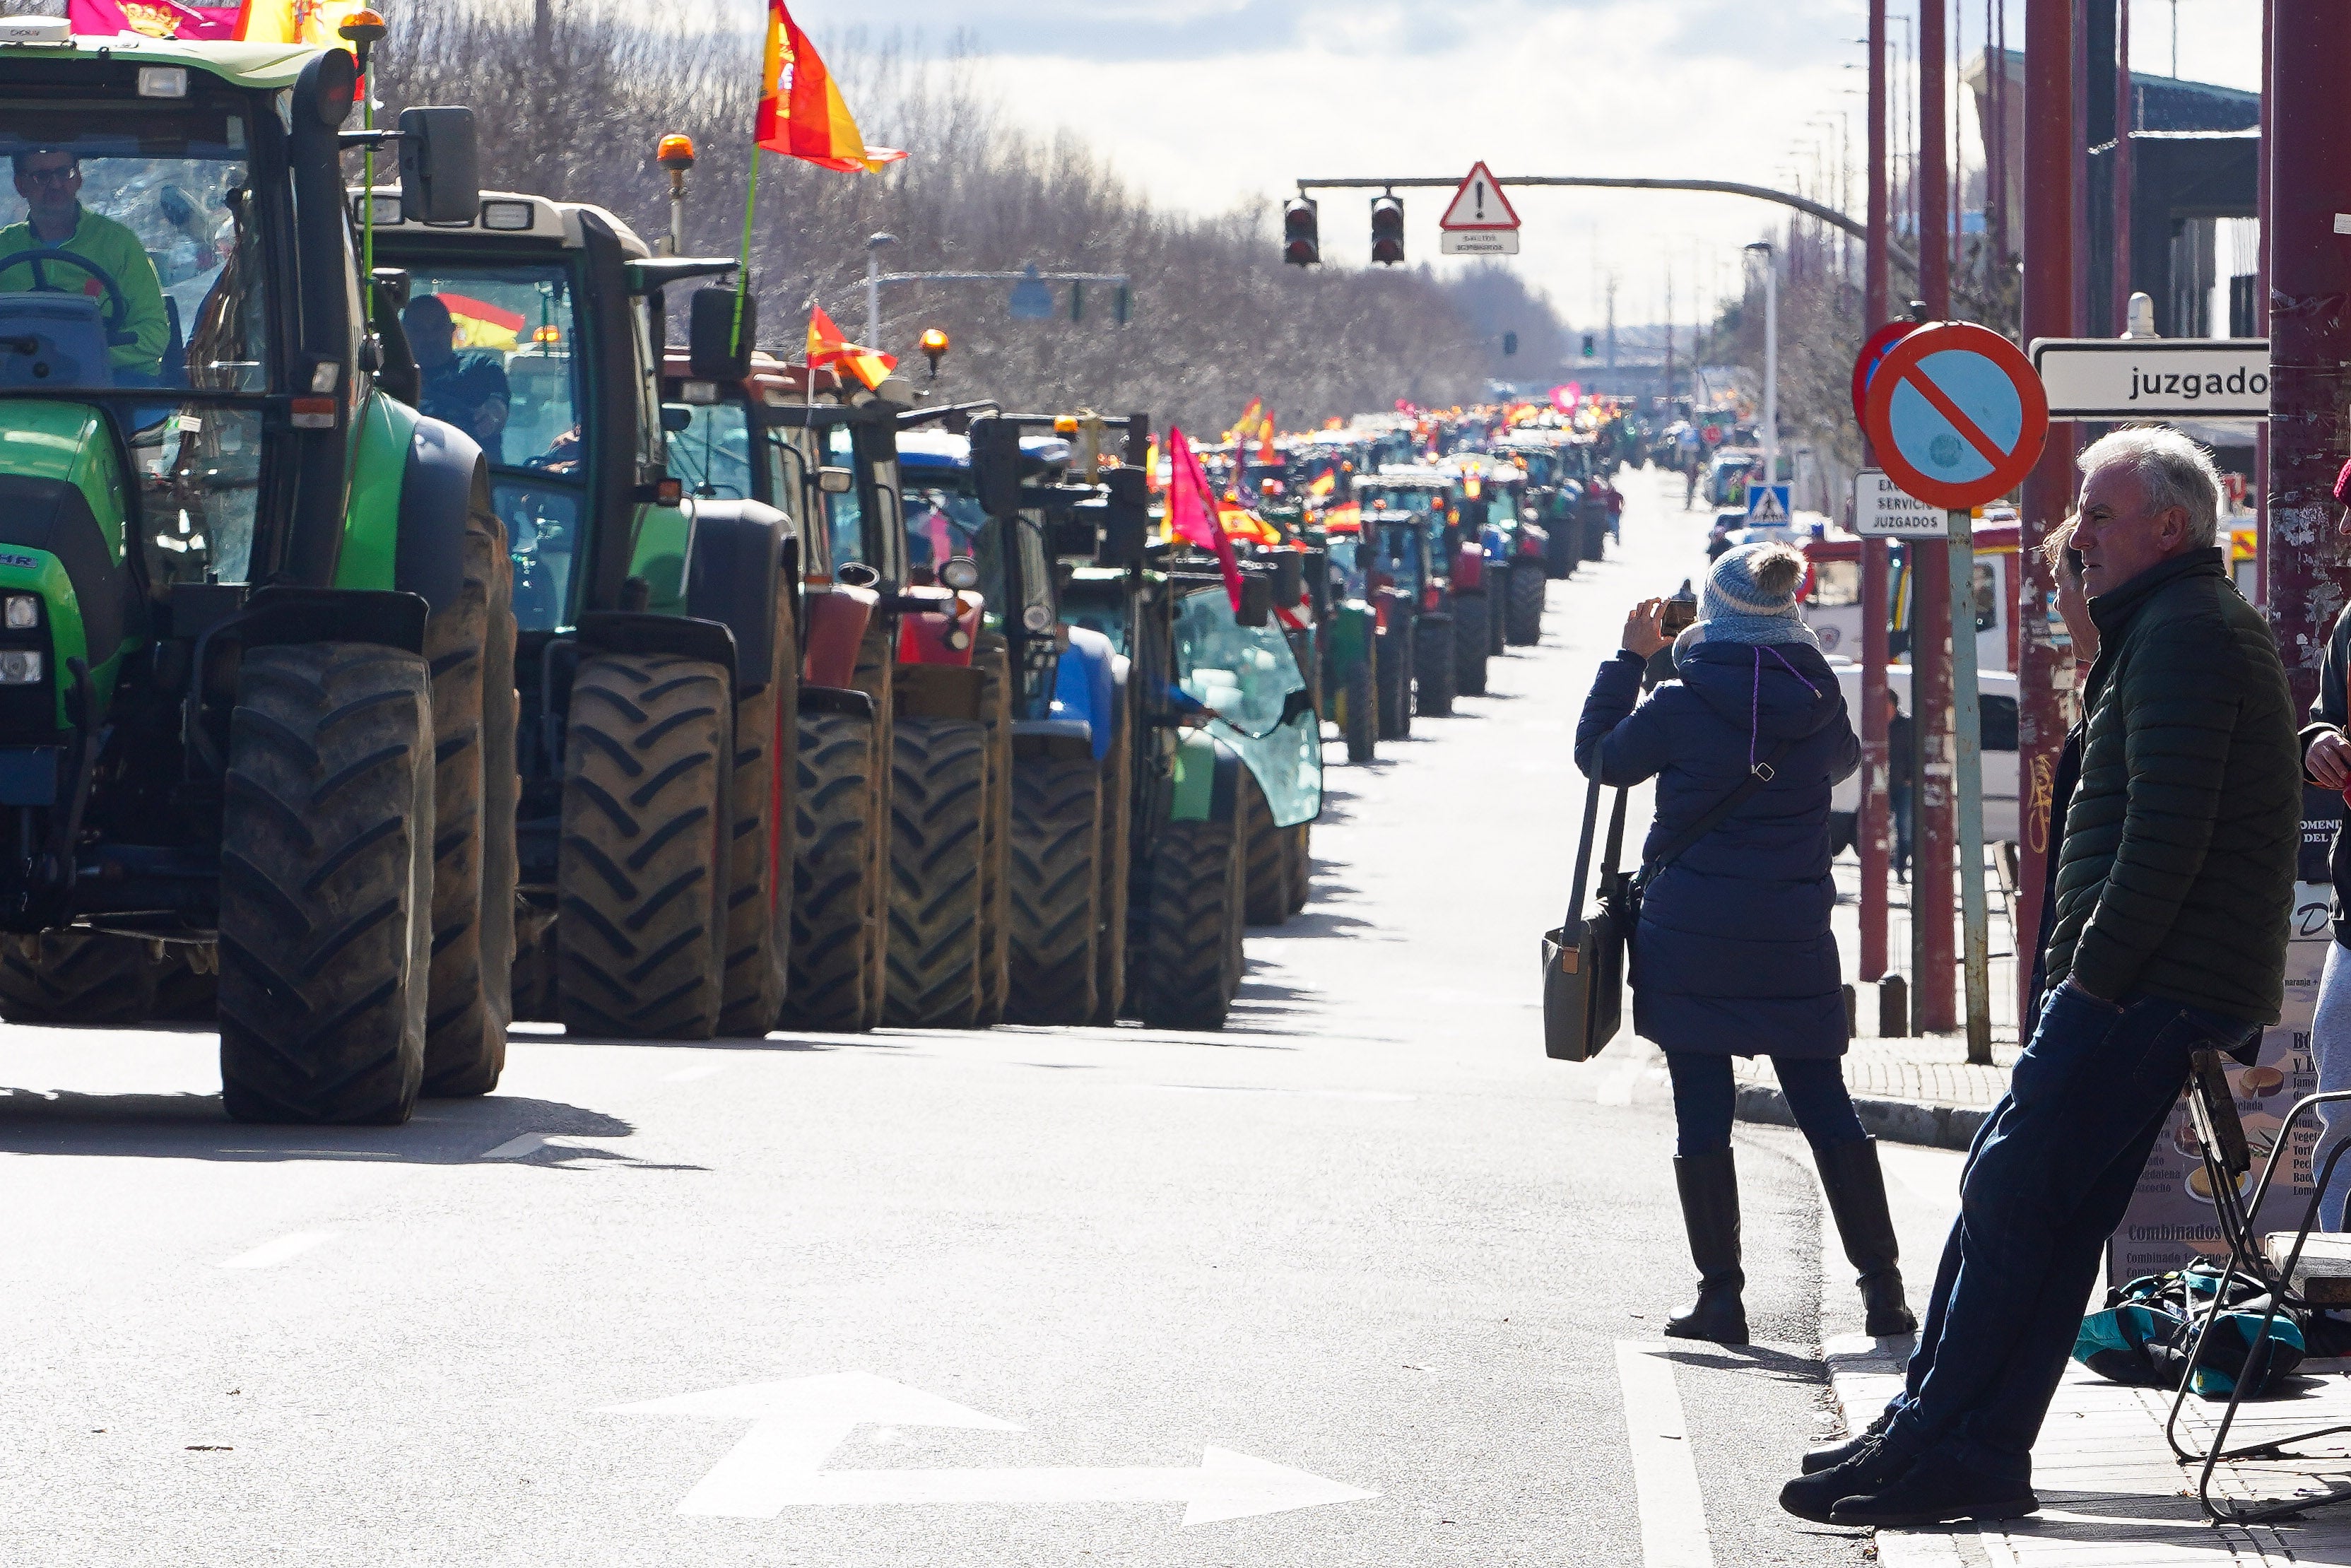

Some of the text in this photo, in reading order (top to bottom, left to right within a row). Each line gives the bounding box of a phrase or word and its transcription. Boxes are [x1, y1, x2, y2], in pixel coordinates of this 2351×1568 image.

[1873, 517, 1938, 528] JUZGADOS
[2304, 834, 2328, 842] DEL
[2128, 1223, 2221, 1240] Combinados
